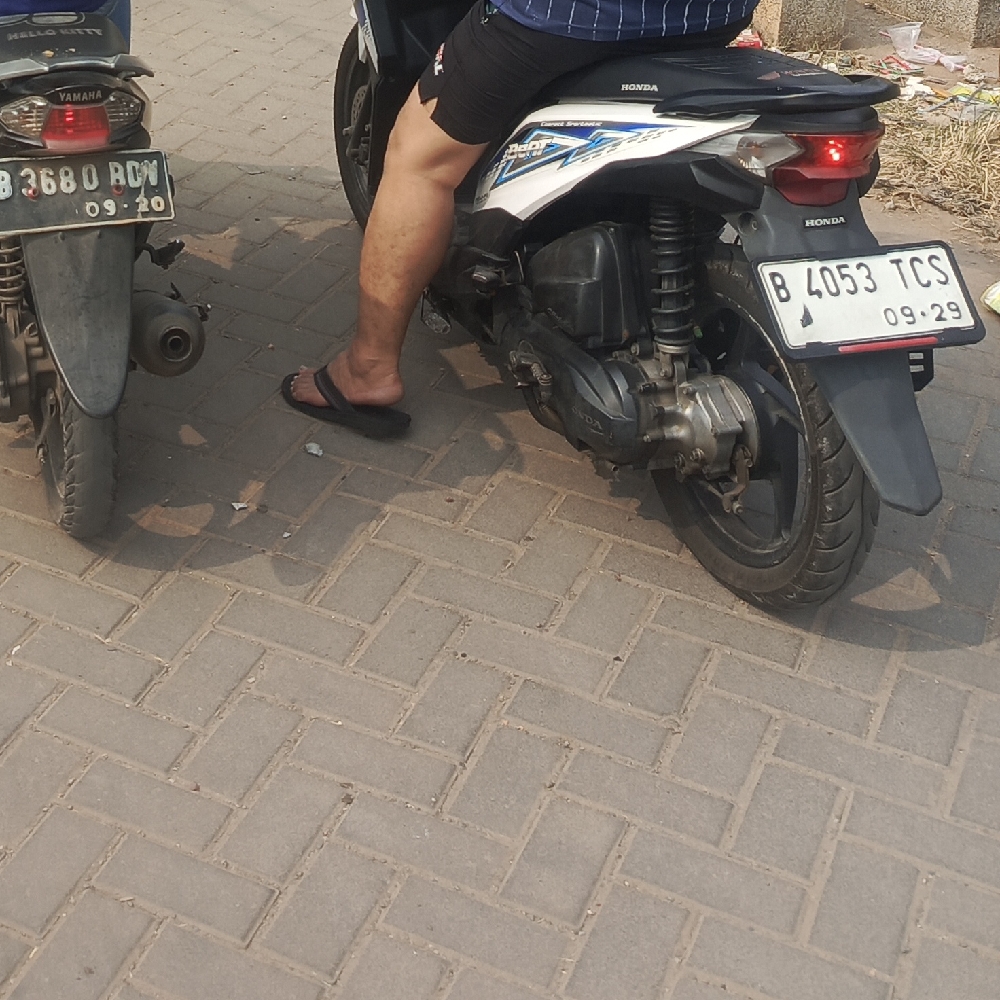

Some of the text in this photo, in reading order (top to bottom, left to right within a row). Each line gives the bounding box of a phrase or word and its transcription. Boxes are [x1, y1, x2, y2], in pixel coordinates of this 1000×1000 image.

[621, 83, 659, 92] HONDA
[59, 89, 103, 102] YAMAHA
[20, 163, 100, 199] 3680
[805, 216, 846, 227] HONDA
[768, 254, 949, 303] B 4053 TCS
